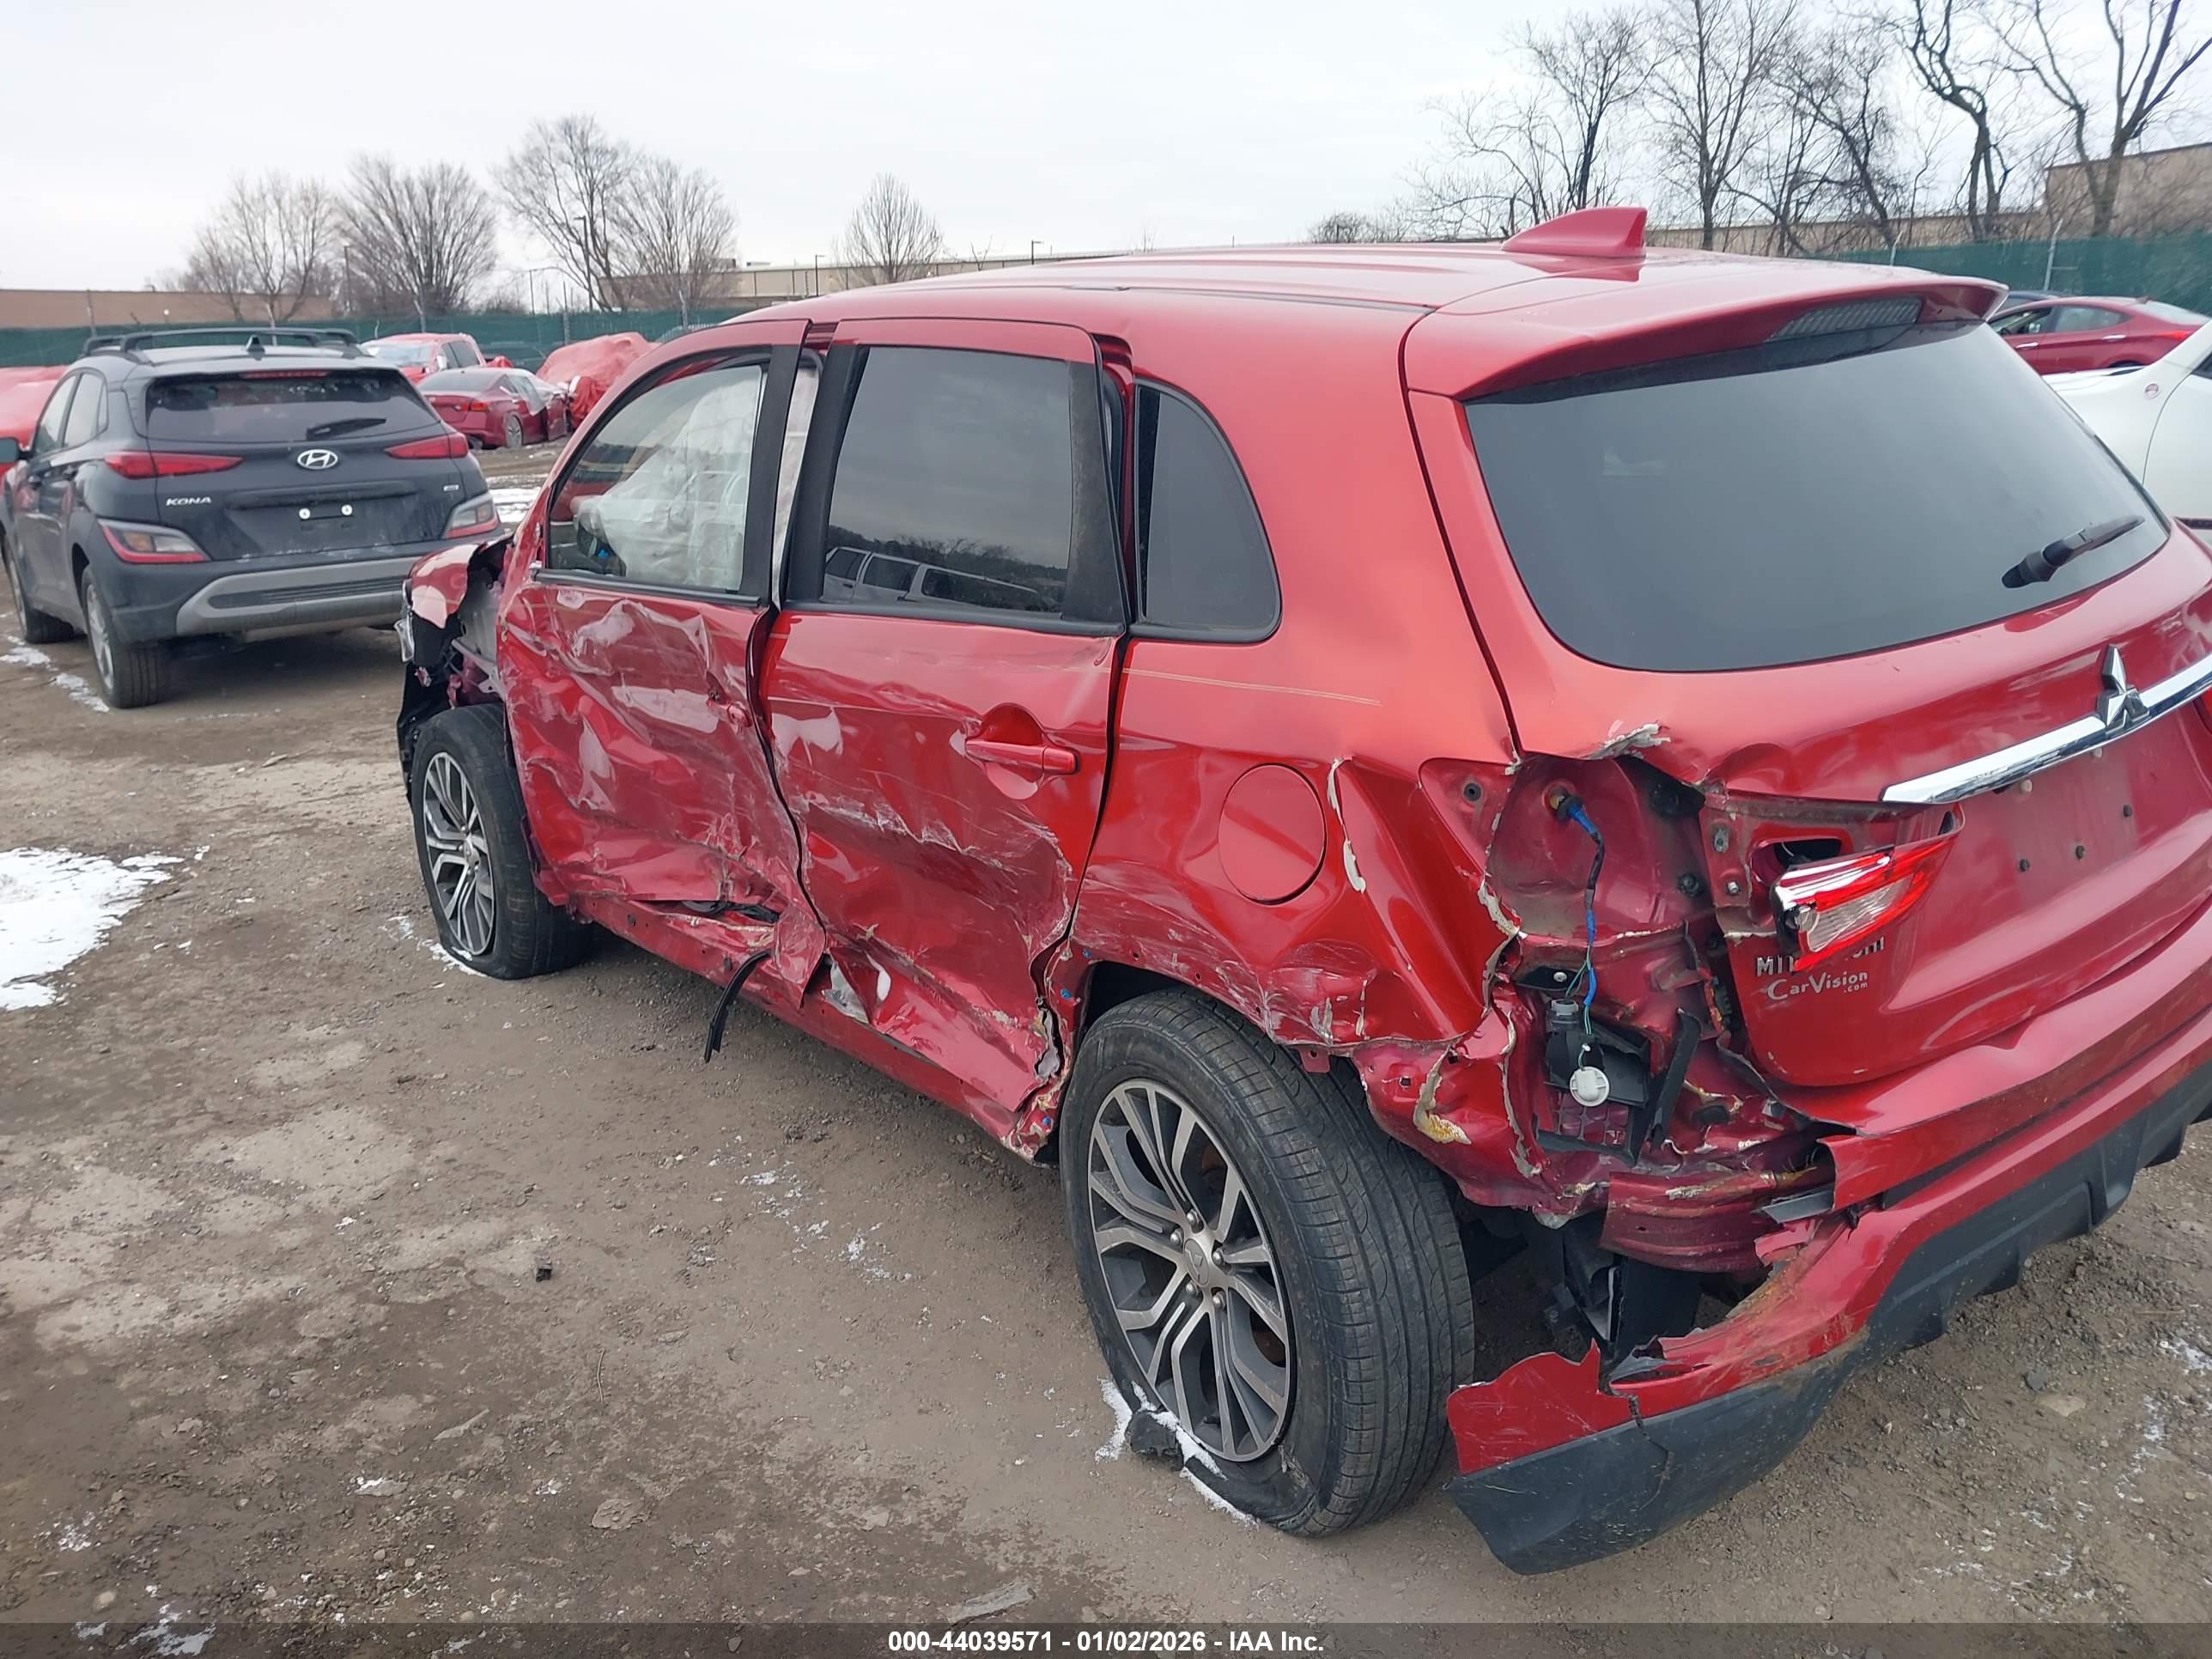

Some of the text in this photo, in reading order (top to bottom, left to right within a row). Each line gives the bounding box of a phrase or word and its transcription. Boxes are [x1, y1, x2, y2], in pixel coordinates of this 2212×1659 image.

[166, 496, 212, 507] KONA
[1766, 970, 1869, 1000] CarVision
[1843, 981, 1869, 994] .com
